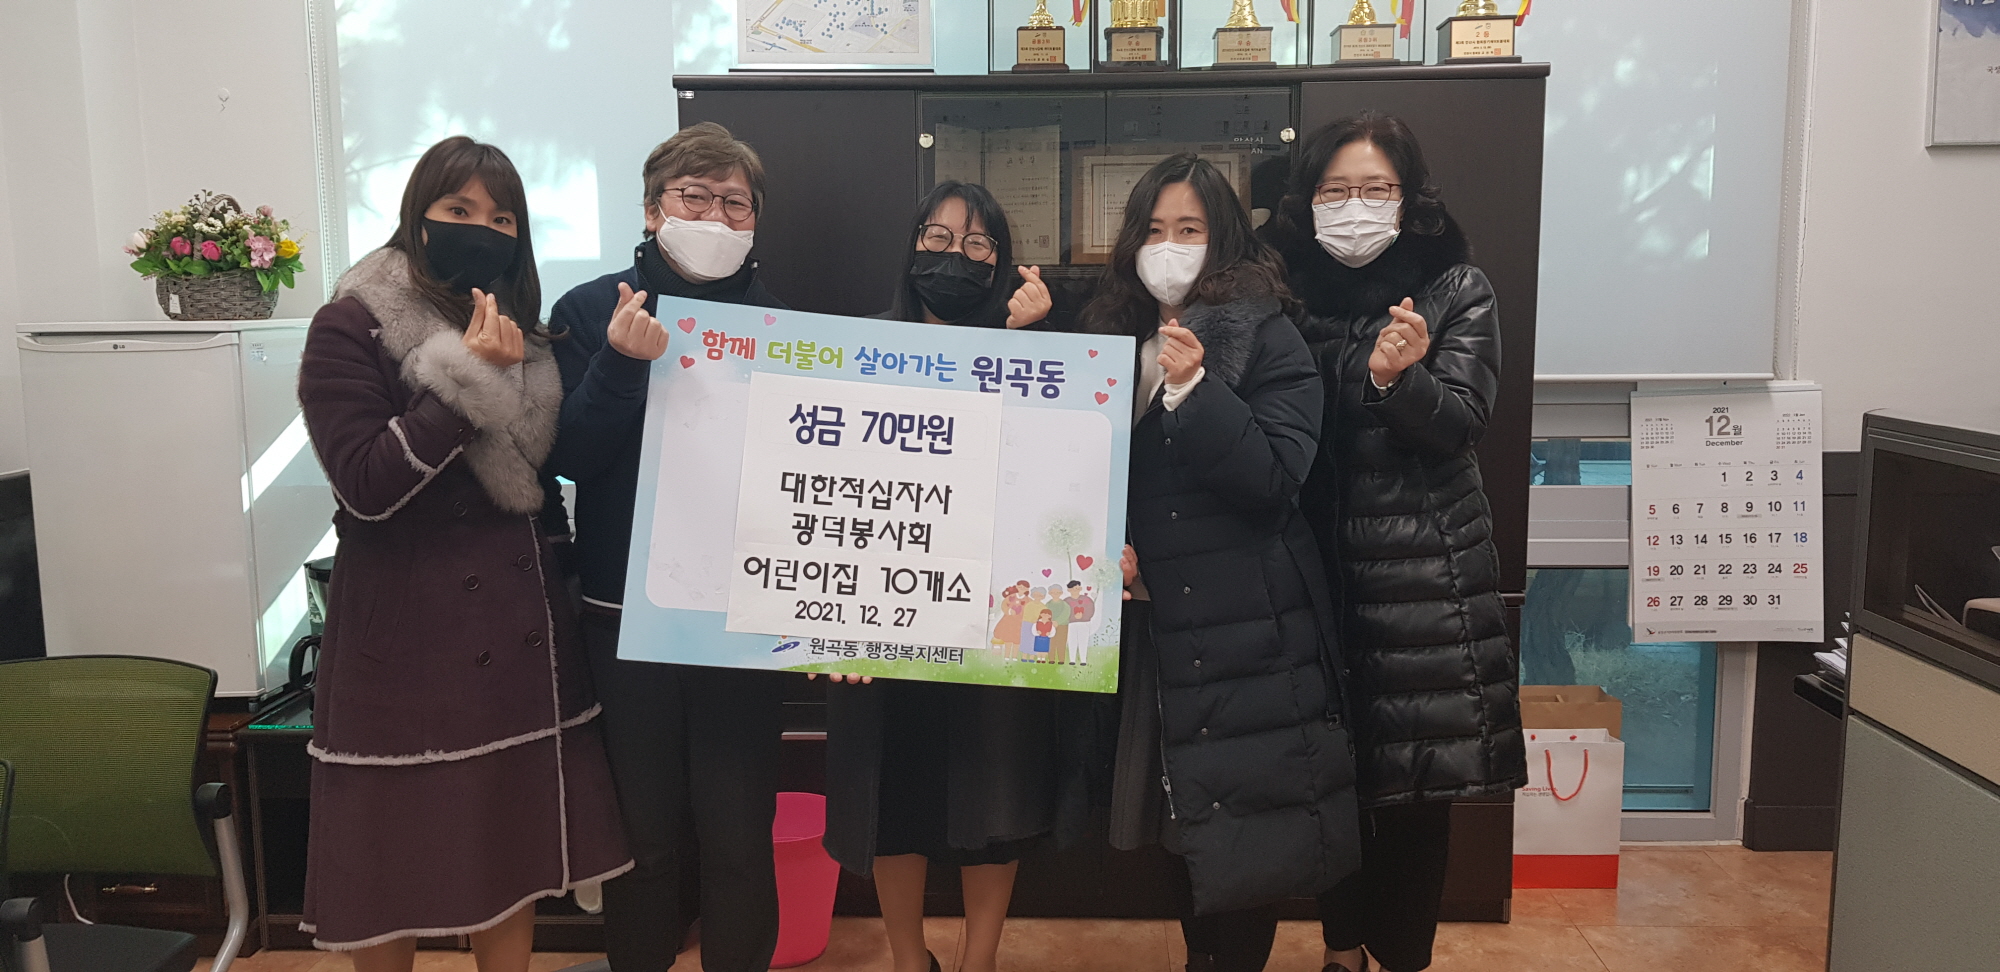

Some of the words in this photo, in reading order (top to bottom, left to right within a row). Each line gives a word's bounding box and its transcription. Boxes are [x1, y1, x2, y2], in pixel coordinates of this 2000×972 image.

[702, 329, 756, 360] 함께
[767, 340, 843, 370] 더불어
[854, 346, 957, 382] 살아가는
[971, 356, 1065, 399] 원곡동
[788, 403, 846, 447] 성금
[861, 410, 954, 455] 70만원
[1705, 415, 1743, 437] 12월
[1721, 472, 1727, 483] 1
[1745, 471, 1753, 482] 2
[1770, 470, 1778, 481] 3
[1795, 470, 1804, 481] 4
[781, 471, 953, 515] 대한적십자사
[1648, 505, 1656, 515] 5
[1672, 504, 1680, 515] 6
[1696, 503, 1704, 514] 7
[1720, 503, 1729, 513] 8
[1745, 502, 1754, 513] 9
[1769, 501, 1781, 511] 10
[1794, 501, 1805, 511] 11
[792, 512, 932, 553] 광덕봉사회
[1647, 536, 1659, 545] 12
[1670, 535, 1683, 545] 13
[1695, 534, 1707, 544] 14
[1719, 534, 1732, 543] 15
[1744, 533, 1756, 543] 16
[1769, 533, 1781, 543] 17
[1794, 532, 1807, 542] 18
[743, 556, 859, 596] 어린이집
[880, 566, 972, 602] 10개소
[1647, 566, 1659, 576] 19
[1670, 565, 1683, 575] 20
[1694, 565, 1705, 574] 21
[1719, 564, 1732, 574] 22
[1743, 564, 1756, 574] 23
[1768, 564, 1781, 573] 24
[1794, 563, 1807, 573] 25
[794, 599, 846, 624] 2021.
[859, 604, 882, 627] 12.
[893, 607, 917, 628] 27
[1647, 597, 1660, 607] 26
[1670, 596, 1683, 606] 27
[1695, 596, 1708, 605] 28
[1719, 595, 1732, 605] 29
[1743, 595, 1757, 605] 30
[1768, 595, 1780, 605] 31
[809, 637, 859, 658] 원곡동
[866, 642, 964, 665] 행정복지센터
